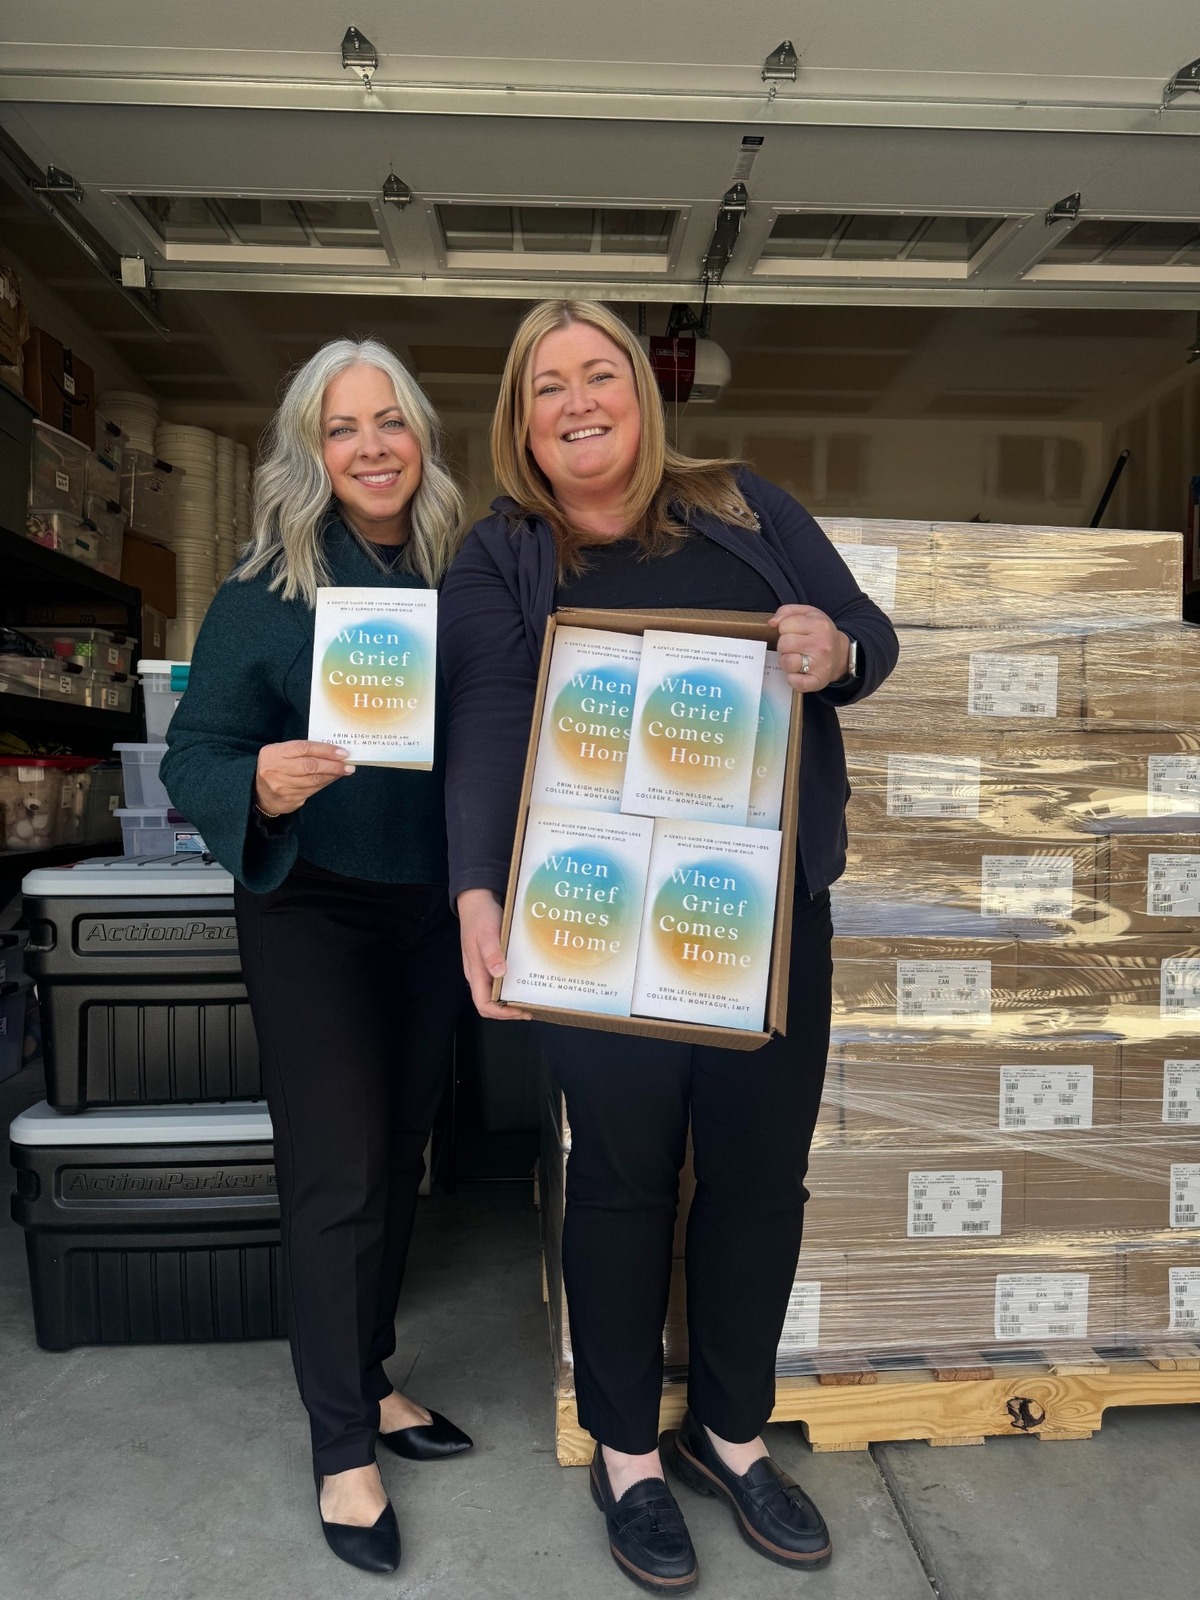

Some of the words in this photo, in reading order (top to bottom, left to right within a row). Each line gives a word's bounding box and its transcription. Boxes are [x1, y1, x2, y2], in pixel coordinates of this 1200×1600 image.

[336, 629, 399, 645] When
[349, 650, 411, 667] Grief
[328, 670, 405, 687] Comes
[570, 673, 632, 695] When
[660, 678, 722, 699] When
[353, 692, 418, 709] Home
[580, 697, 630, 718] Grie
[670, 701, 733, 723] Grief
[558, 716, 631, 740] Comes
[648, 721, 724, 745] Comes
[579, 741, 628, 762] Hom
[670, 746, 735, 770] Home
[544, 786, 574, 795] COLLEEN
[583, 792, 621, 802] MONTAGUE
[593, 787, 620, 795] NELSON
[636, 793, 665, 801] COLLEEN
[686, 792, 712, 800] NELSON
[543, 855, 608, 878] When
[671, 868, 736, 891] When
[554, 880, 619, 904] Grief
[531, 901, 609, 927] Comes
[682, 893, 748, 918] Grief
[85, 922, 238, 941] ActionPac
[659, 914, 739, 941] Comes
[552, 928, 620, 953] Home
[681, 942, 751, 968] Home
[516, 978, 547, 987] COLLEEN
[568, 978, 595, 986] NELSON
[646, 992, 677, 1001] COLLEEN
[732, 1004, 750, 1012] LMFT
[659, 986, 675, 994] ERIN
[677, 989, 697, 997] LEIGH
[698, 992, 726, 1001] NELSON
[70, 1171, 261, 1191] ActionPacker
